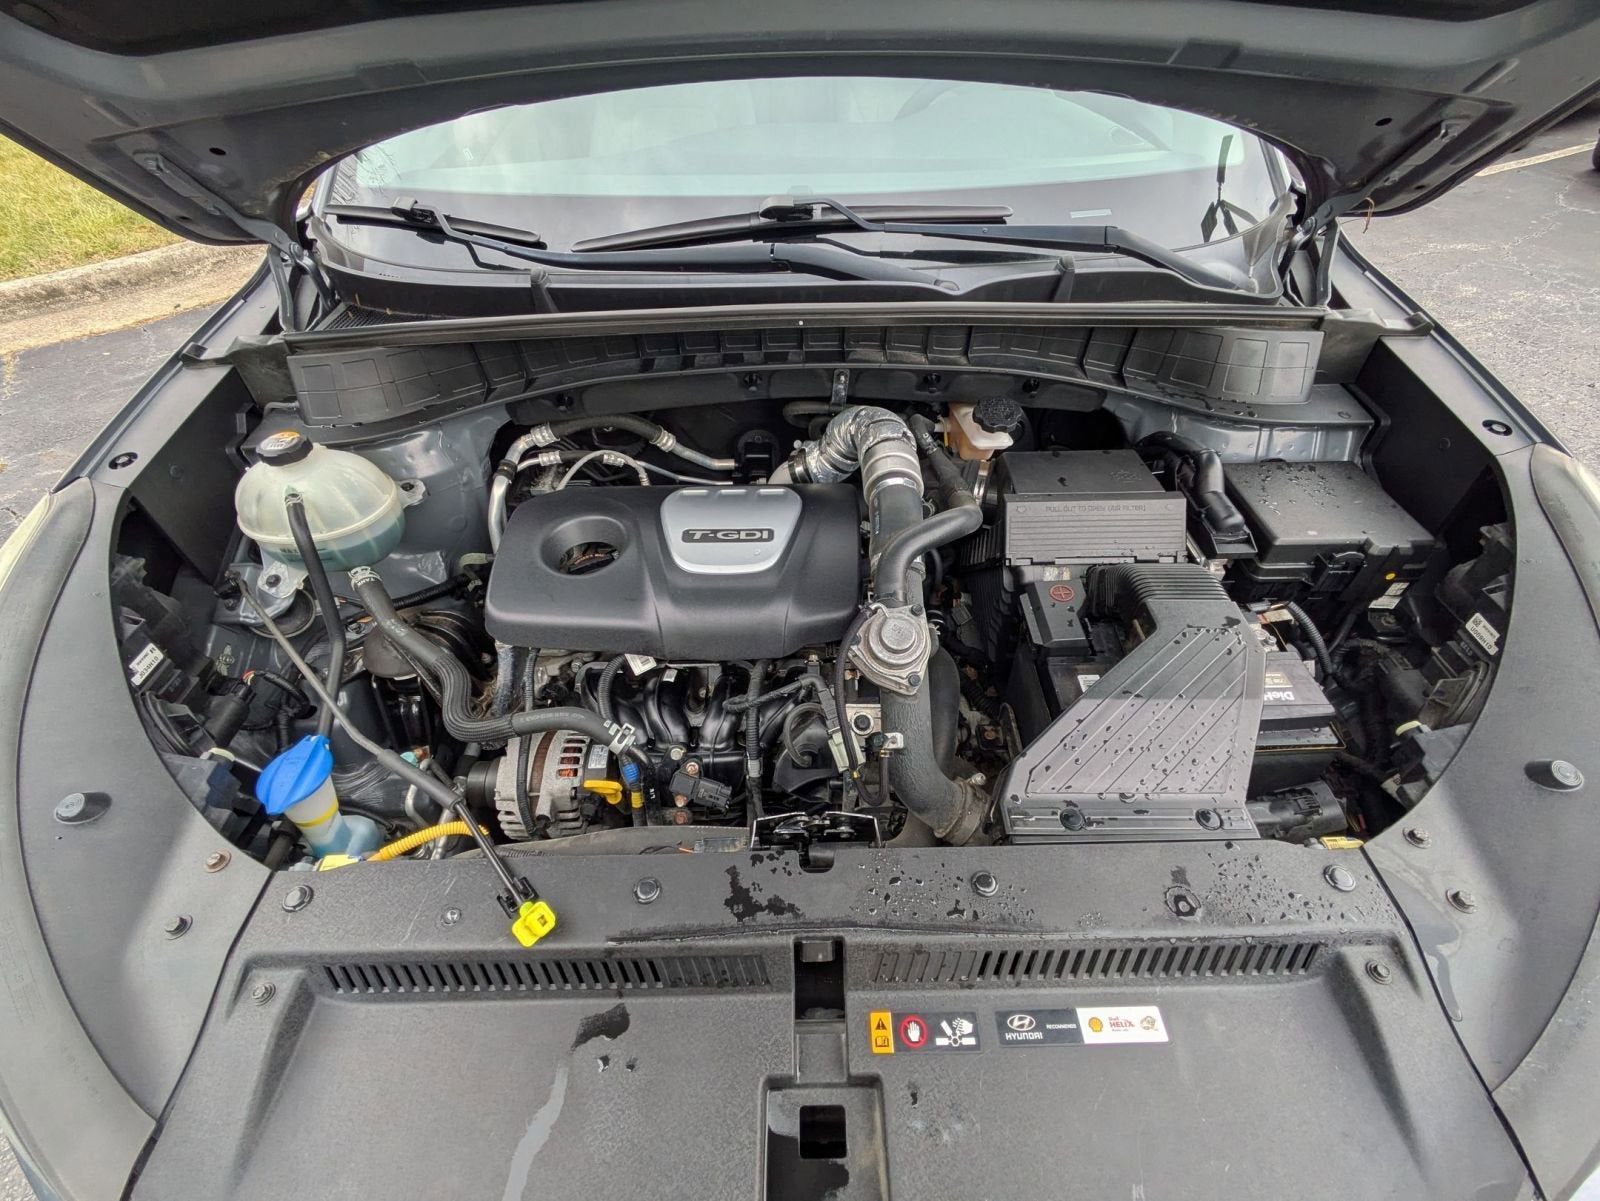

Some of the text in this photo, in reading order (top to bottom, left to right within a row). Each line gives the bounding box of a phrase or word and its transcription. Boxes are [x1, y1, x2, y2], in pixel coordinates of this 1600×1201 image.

[688, 530, 769, 540] T-GDI
[1264, 691, 1295, 701] DieH
[1005, 1032, 1044, 1041] HYUNDAI
